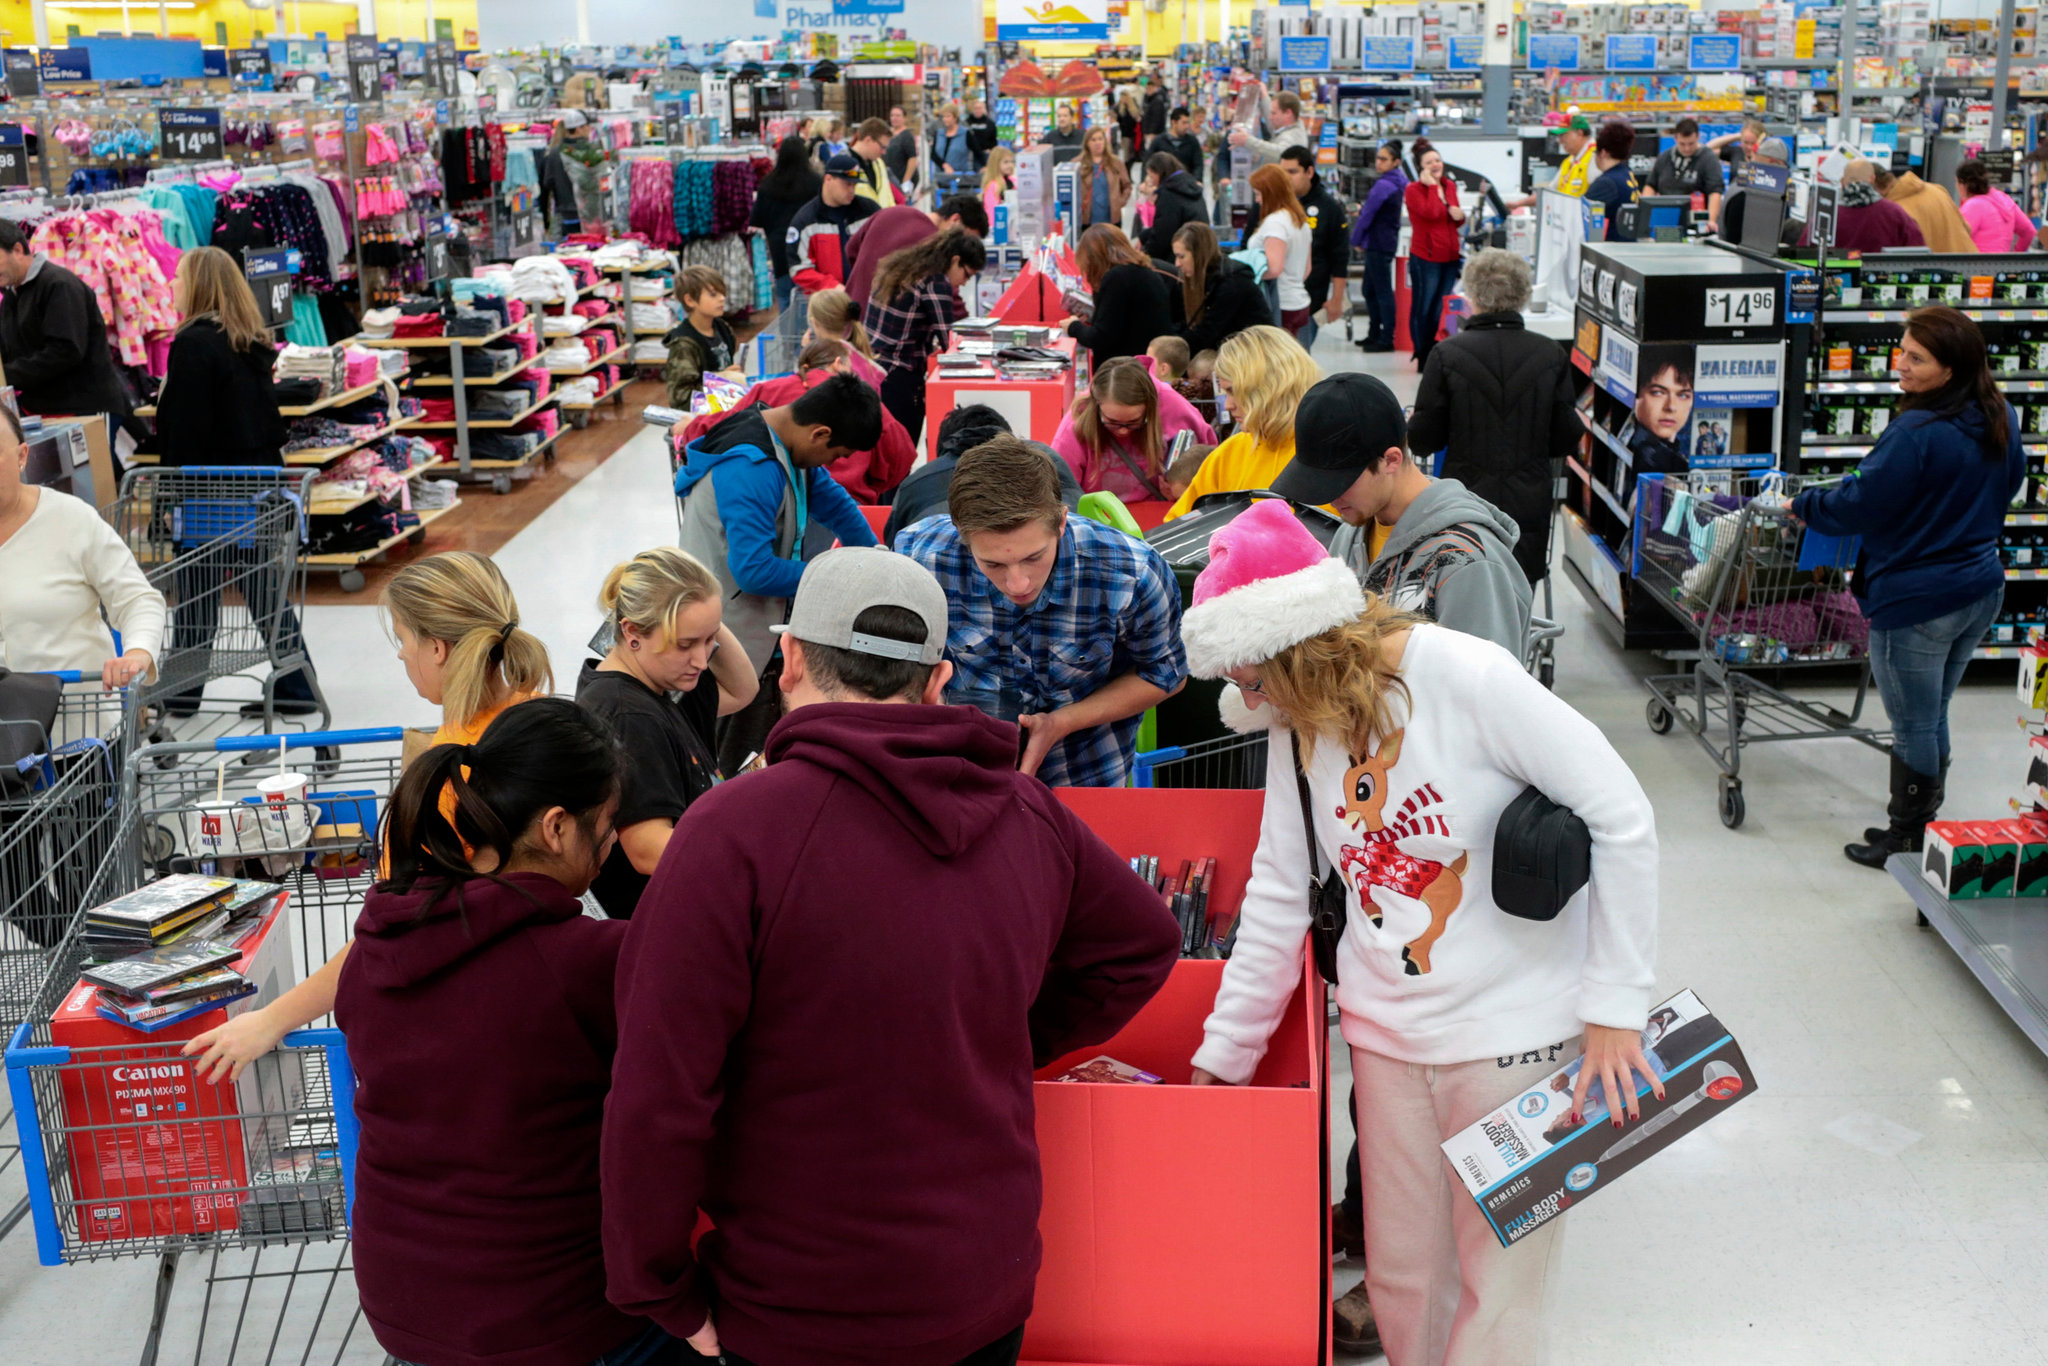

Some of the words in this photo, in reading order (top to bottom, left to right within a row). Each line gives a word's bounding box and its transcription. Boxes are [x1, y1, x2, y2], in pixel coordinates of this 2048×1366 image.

[787, 8, 889, 27] Pharmacy
[1701, 360, 1777, 376] VALERIAN
[270, 812, 290, 820] WATER
[202, 837, 222, 846] WATER
[66, 986, 98, 1012] Canon
[136, 1006, 167, 1020] VACATION
[112, 1064, 184, 1082] Canon
[116, 1088, 152, 1100] PIXMA
[153, 1085, 186, 1096] MX490
[1480, 1120, 1505, 1148] BODY
[1498, 1120, 1531, 1161] MASSAGER
[1498, 1141, 1520, 1168] FULL
[1504, 1210, 1536, 1234] FULL
[1532, 1187, 1566, 1215] BODY
[1508, 1204, 1560, 1242] MASSAGER
